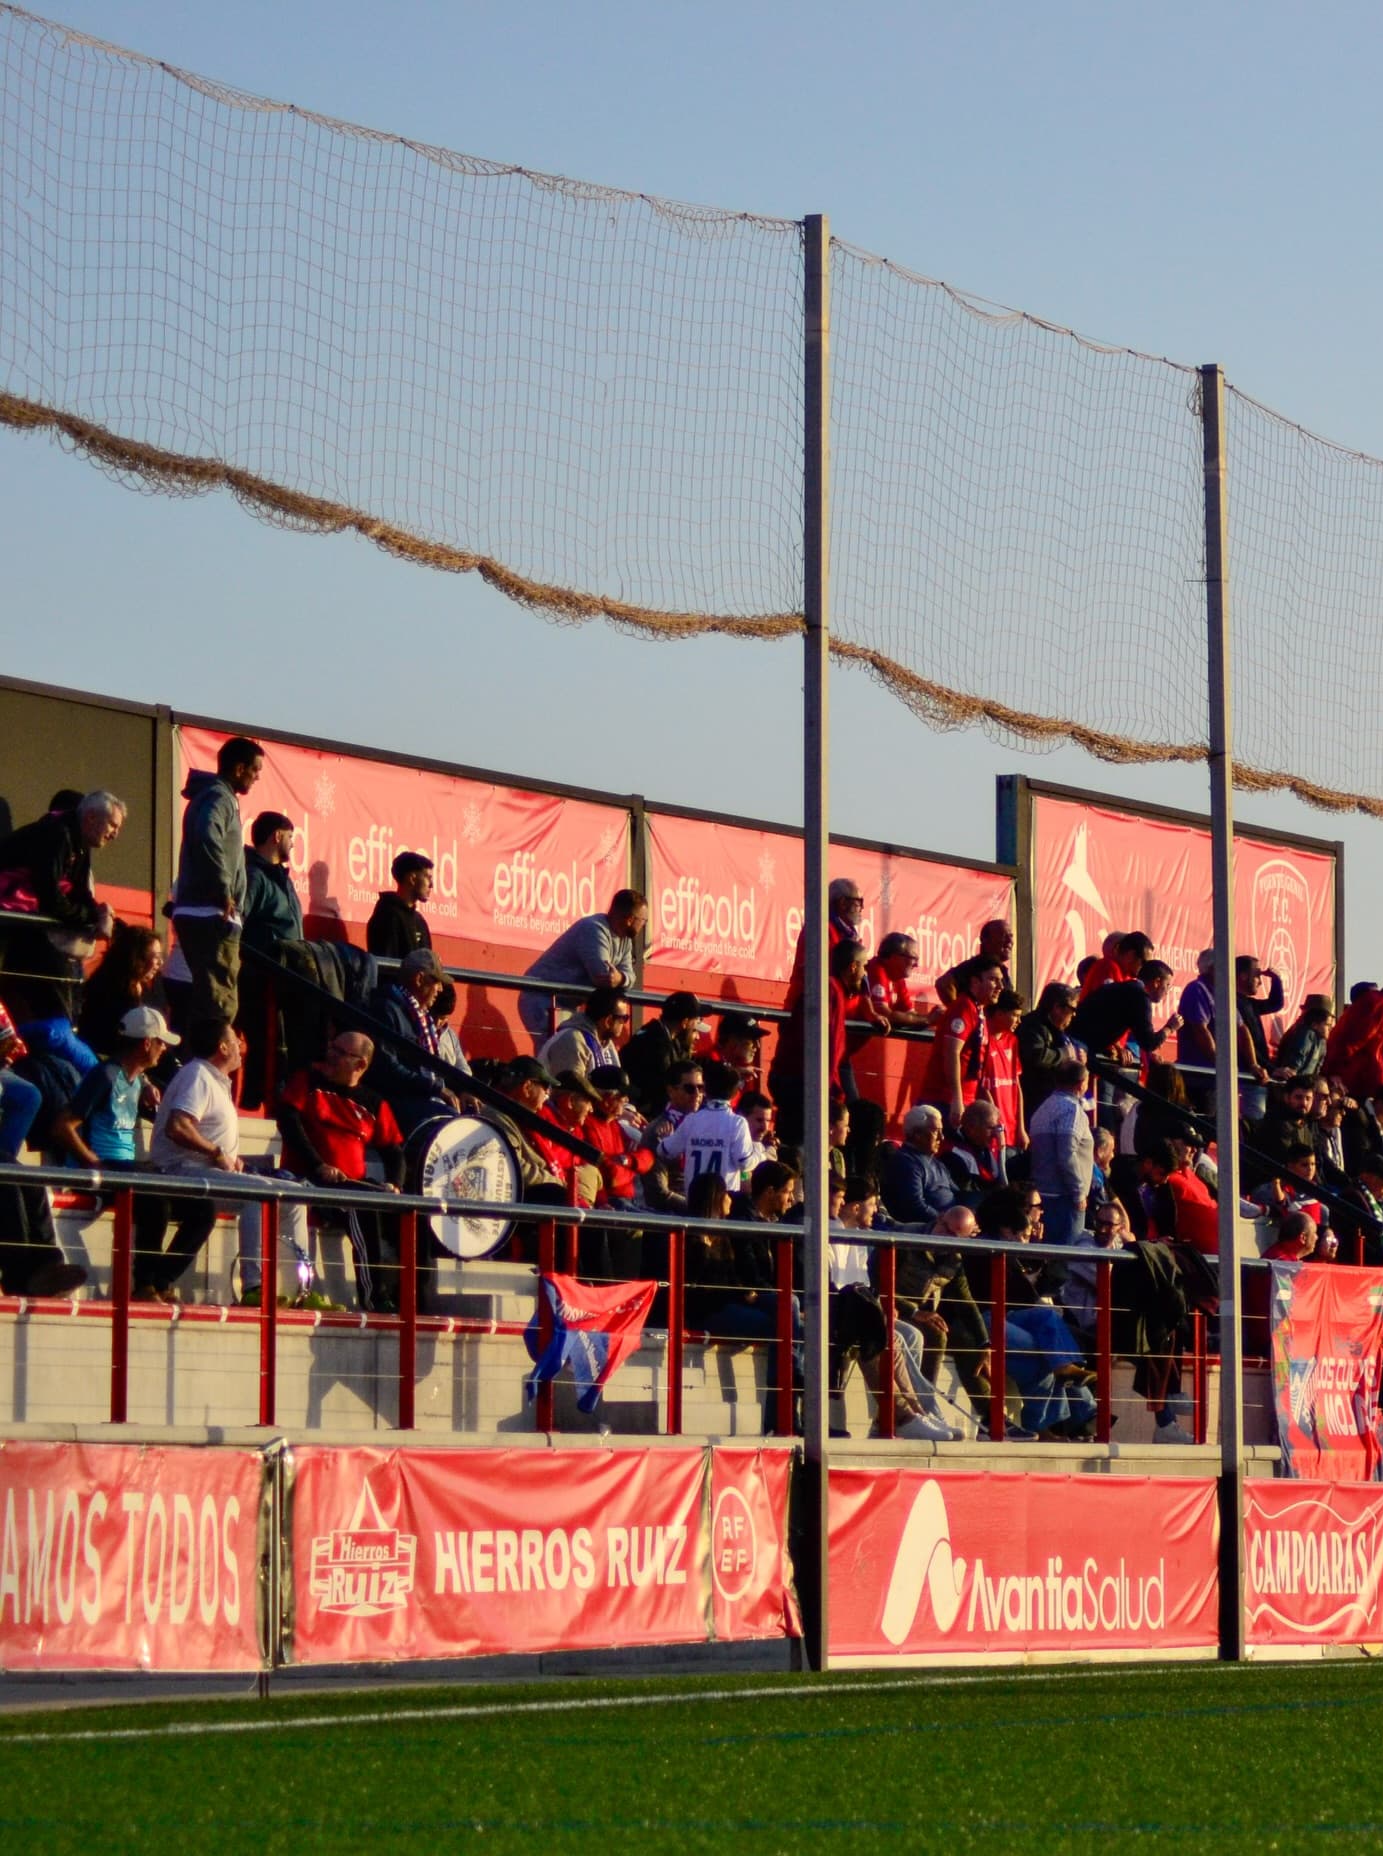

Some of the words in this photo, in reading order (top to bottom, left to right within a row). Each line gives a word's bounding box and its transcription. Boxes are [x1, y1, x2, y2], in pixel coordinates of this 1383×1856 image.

[349, 823, 458, 898] effild
[493, 849, 596, 918] efficold
[494, 908, 529, 929] Partners
[660, 875, 756, 941] efficold
[690, 1151, 722, 1177] 14
[340, 1535, 391, 1562] Hierros
[721, 1516, 745, 1540] RF
[122, 1492, 241, 1626] TODOS
[331, 1562, 399, 1604] Ruiz
[434, 1528, 595, 1594] HIERROS
[607, 1525, 687, 1588] RUIZ
[720, 1552, 749, 1573] EF
[1251, 1528, 1368, 1595] CAMPOARAS
